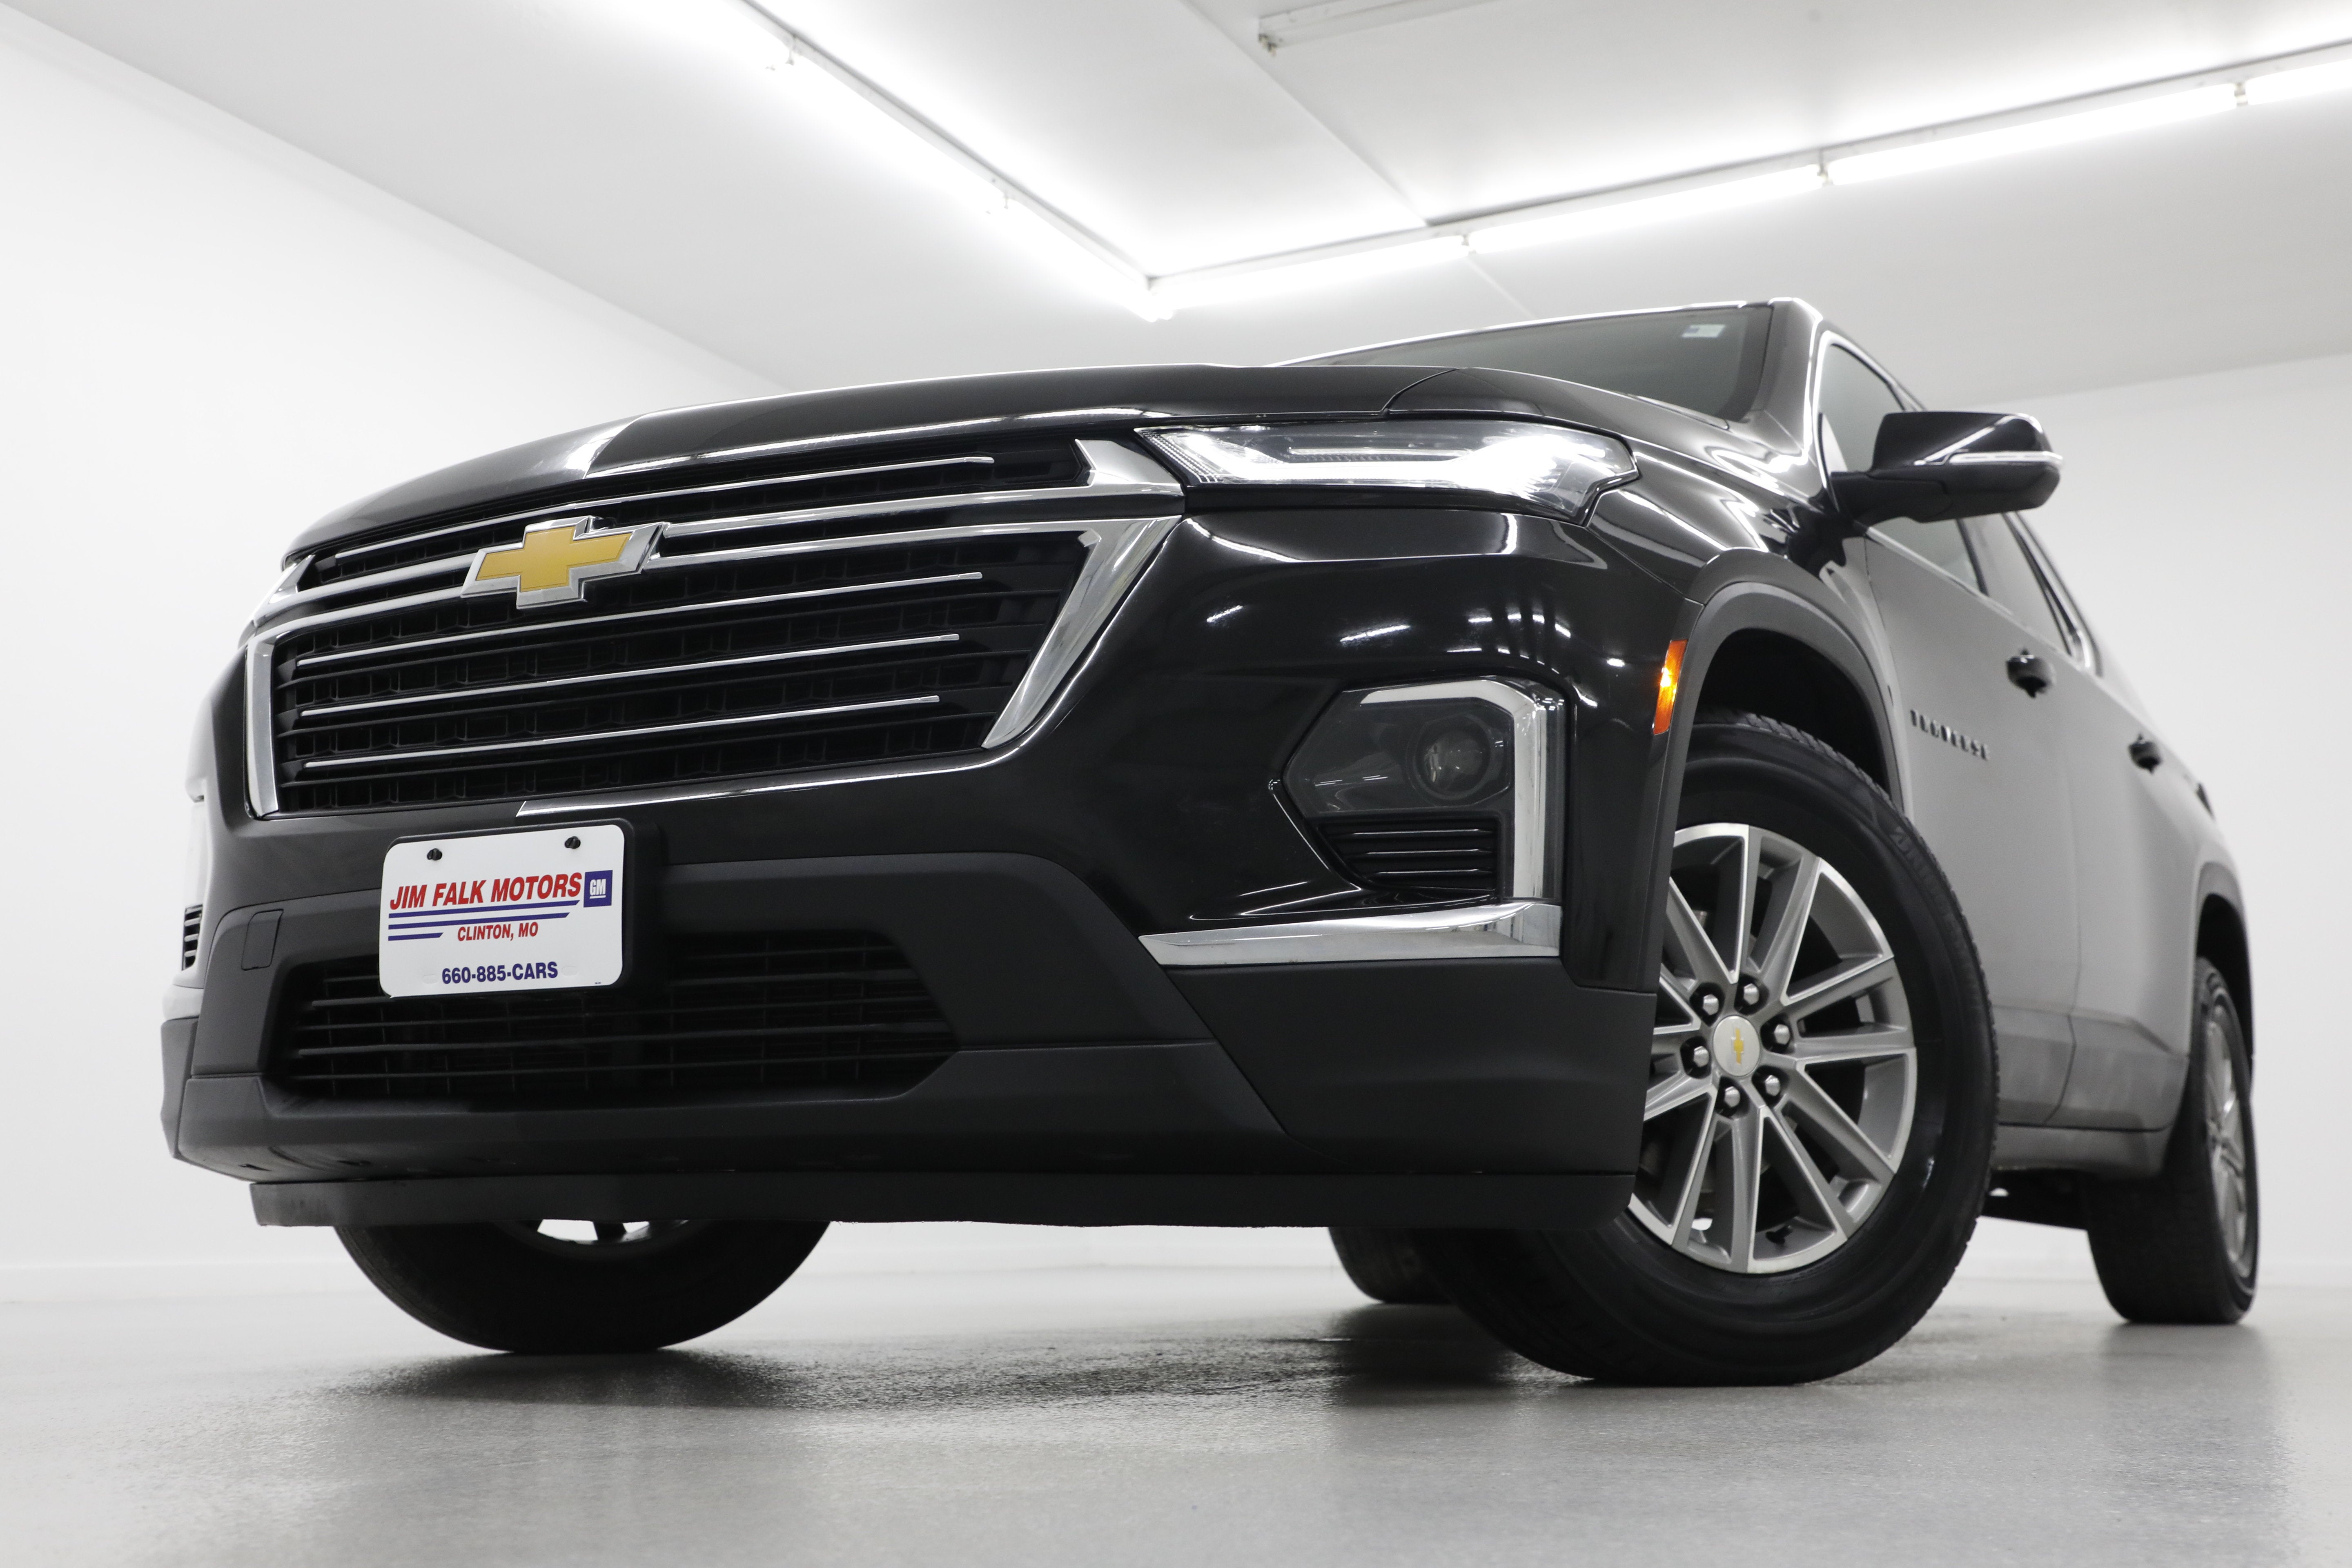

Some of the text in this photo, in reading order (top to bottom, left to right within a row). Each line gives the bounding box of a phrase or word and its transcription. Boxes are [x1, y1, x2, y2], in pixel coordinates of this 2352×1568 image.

[390, 873, 582, 910] JIM FALK MOTORS
[590, 878, 606, 895] GM
[458, 922, 538, 941] CLINTON, MO
[442, 962, 558, 984] 660-885-CARS
